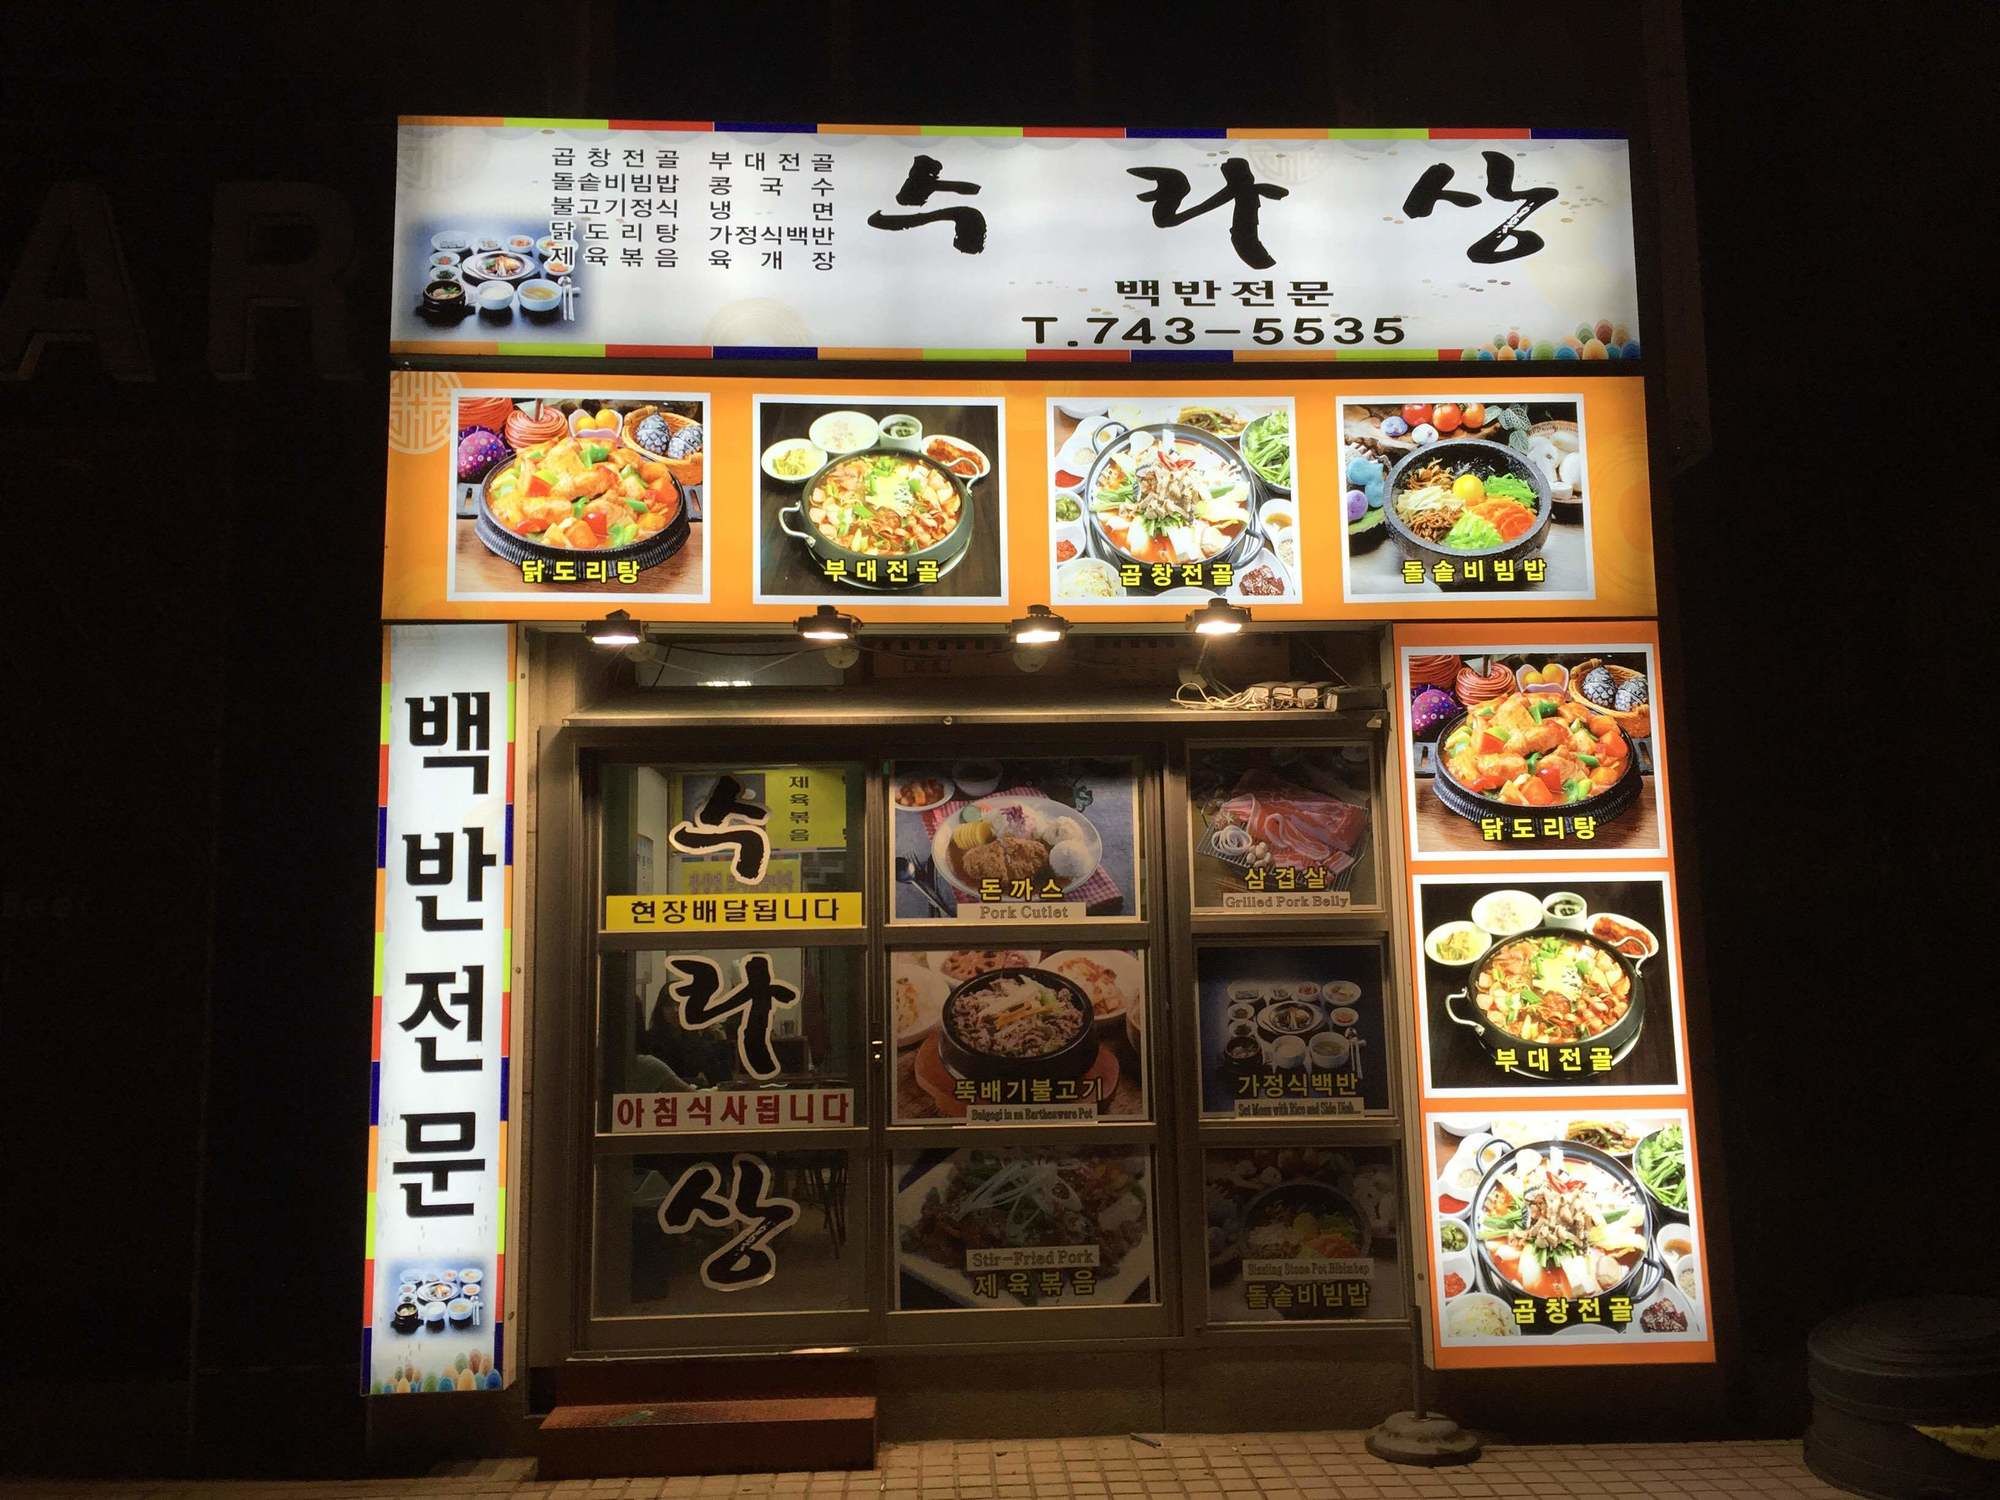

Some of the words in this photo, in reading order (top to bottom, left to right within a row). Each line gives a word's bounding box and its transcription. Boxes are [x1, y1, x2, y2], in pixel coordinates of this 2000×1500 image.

[551, 147, 679, 168] 곱창전골
[708, 151, 836, 172] 부대전골
[551, 172, 680, 193] 돌솥비빔밥
[708, 175, 836, 197] 콩국수
[551, 196, 679, 219] 불고기정식
[708, 200, 835, 222] 냉면
[551, 221, 679, 243] 닭도리탕
[708, 225, 836, 247] 가정식백반
[550, 245, 680, 268] 제육볶음
[708, 249, 836, 271] 육개장
[1114, 279, 1336, 309] 백반전문
[1022, 316, 1406, 347] T.743-5535
[521, 558, 642, 585] 닭도리탕
[822, 558, 941, 584] 부대전골
[1118, 561, 1236, 588] 곱창전골
[1400, 557, 1549, 585] 돌솥비빔밥
[1480, 816, 1598, 842] 닭도리탕
[979, 877, 1065, 902] 돈까스
[1244, 866, 1329, 891] 삼겹살
[630, 897, 840, 925] 현장배달됩니다
[979, 905, 1019, 920] Pork
[1021, 904, 1070, 919] Cutlet
[1224, 896, 1274, 909] Grilled
[1276, 896, 1309, 909] Pork
[1312, 895, 1349, 909] Belly
[393, 691, 496, 1218] 백반전문
[1495, 1046, 1614, 1073] 부대전골
[954, 1077, 1105, 1104] 뚝배기불고기
[1237, 1072, 1360, 1098] 가정식백반
[616, 1092, 849, 1129] 아침식사됩니다
[1057, 1249, 1094, 1264] Pork
[973, 1269, 1098, 1298] 제육볶음
[1246, 1281, 1371, 1310] 돌솥비빔밥
[1512, 1296, 1634, 1325] 곱창전골
